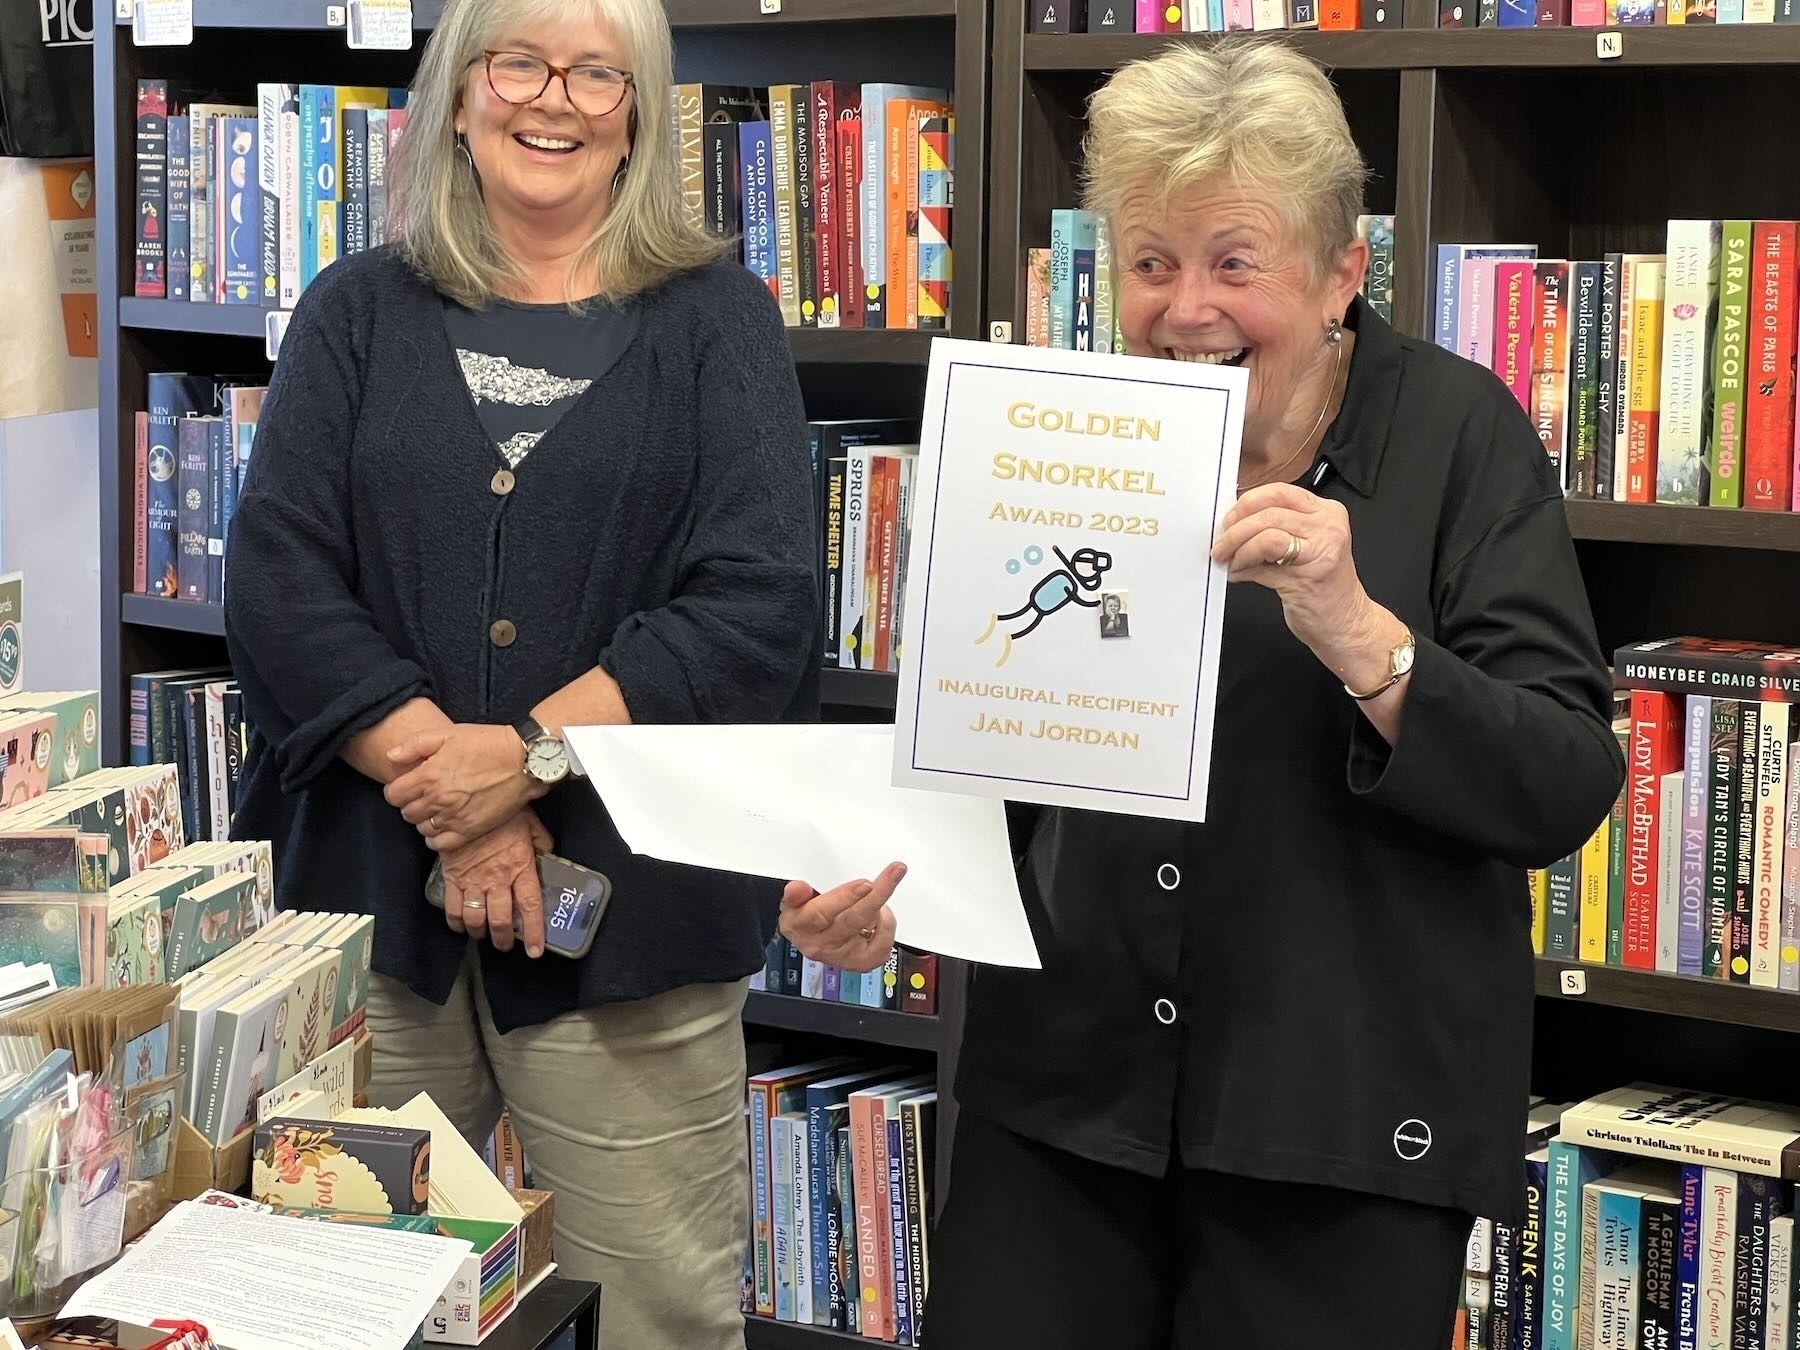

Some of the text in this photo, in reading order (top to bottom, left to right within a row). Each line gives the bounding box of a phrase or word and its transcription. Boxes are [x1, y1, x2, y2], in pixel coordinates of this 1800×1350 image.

[773, 101, 785, 132] EMMA
[797, 102, 806, 122] THE
[172, 157, 185, 166] THE
[680, 95, 702, 182] SYLVIA
[797, 125, 809, 182] MADISON
[167, 169, 190, 177] GOOD
[169, 180, 188, 189] WIFE
[774, 135, 789, 192] DONOGHUE
[168, 203, 188, 211] BATH
[173, 192, 183, 200] OF
[345, 129, 354, 256] SYMPATHY CHIDGEY
[746, 164, 758, 265] ANTHONY DOERR
[756, 140, 768, 246] CLOUD CUCKOO
[800, 185, 809, 208] GAP
[778, 200, 791, 247] LEARNED
[136, 249, 164, 257] BROOKS
[780, 251, 792, 263] BY
[1051, 229, 1061, 292] O'CONNOR
[1060, 240, 1069, 281] JOSEPH
[780, 264, 794, 301] HEART
[1442, 258, 1455, 331] Valérie Perrin
[1761, 233, 1781, 372] THE BEASTS OF PARIS
[1040, 297, 1050, 338] WHERE
[1053, 305, 1063, 320] MY
[1095, 281, 1110, 333] EMILY
[1505, 271, 1523, 386] Valérie Perrin
[1538, 275, 1559, 440] The TIME OF OUR SINGING
[1598, 261, 1615, 413] MAX PORTER SHY
[1718, 238, 1745, 478] SARA PASCOE weirdo
[1577, 276, 1594, 461] Bewilderment RICHARD POWERS
[153, 407, 169, 416] KEN
[187, 454, 201, 463] KEN
[224, 415, 233, 488] Good Winter
[1629, 420, 1638, 464] PALMER
[1637, 423, 1646, 462] BOBBY
[181, 460, 206, 472] FOLLETT
[829, 475, 842, 509] TIME
[849, 459, 863, 521] SPRIGS
[827, 511, 841, 569] SHELTER
[884, 521, 892, 566] GETTING
[1088, 511, 1159, 536] 2023
[937, 679, 1179, 717] INAUGURAL RECIPIENT
[1626, 664, 1756, 688] HONEYBEE CRAIG
[1714, 715, 1735, 725] LISA
[1716, 725, 1734, 734] SEE
[1634, 720, 1656, 768] LADY
[1760, 724, 1773, 797] SITTENFELD
[1771, 740, 1782, 784] CURTIS
[229, 754, 239, 781] ONE
[1683, 705, 1704, 931] Compulsion KATE SCOTT
[1711, 747, 1730, 944] LADY TAN'S CIRCLE OF WOMEN
[1758, 805, 1774, 951] ROMANTIC COMEDY
[550, 887, 577, 929] 16:45
[1628, 891, 1639, 952] SCHULER
[1732, 916, 1741, 950] SHAPIRO
[1741, 922, 1750, 945] JOSIE
[891, 947, 899, 974] HOEY
[323, 1062, 345, 1096] wild
[872, 1113, 887, 1194] CURSED BREAD
[1586, 1128, 1771, 1167] Christos Tsiolkas The In Between
[794, 1133, 805, 1286] Amanda Lohrey The Labyrinth
[810, 1106, 824, 1285] Madelaine Lucas Thirst for Salt
[856, 1123, 876, 1279] SUE LANDED
[903, 1110, 923, 1314] KIRSTY MANNING THE HIDDEN BOOK
[1551, 1154, 1569, 1333] THE LAST DAYS OF JOY
[1617, 1220, 1633, 1304] Amor The
[1645, 1217, 1660, 1305] IN MOSCOW
[1659, 1212, 1673, 1310] A GENTLEMAN
[1680, 1172, 1700, 1338] Anne Tyler French
[1769, 1234, 1782, 1296] VICKERS
[1521, 1262, 1538, 1278] K
[1598, 1215, 1618, 1350] Towles Highway
[1523, 1284, 1533, 1320] SARAH
[1770, 1322, 1781, 1344] THE
